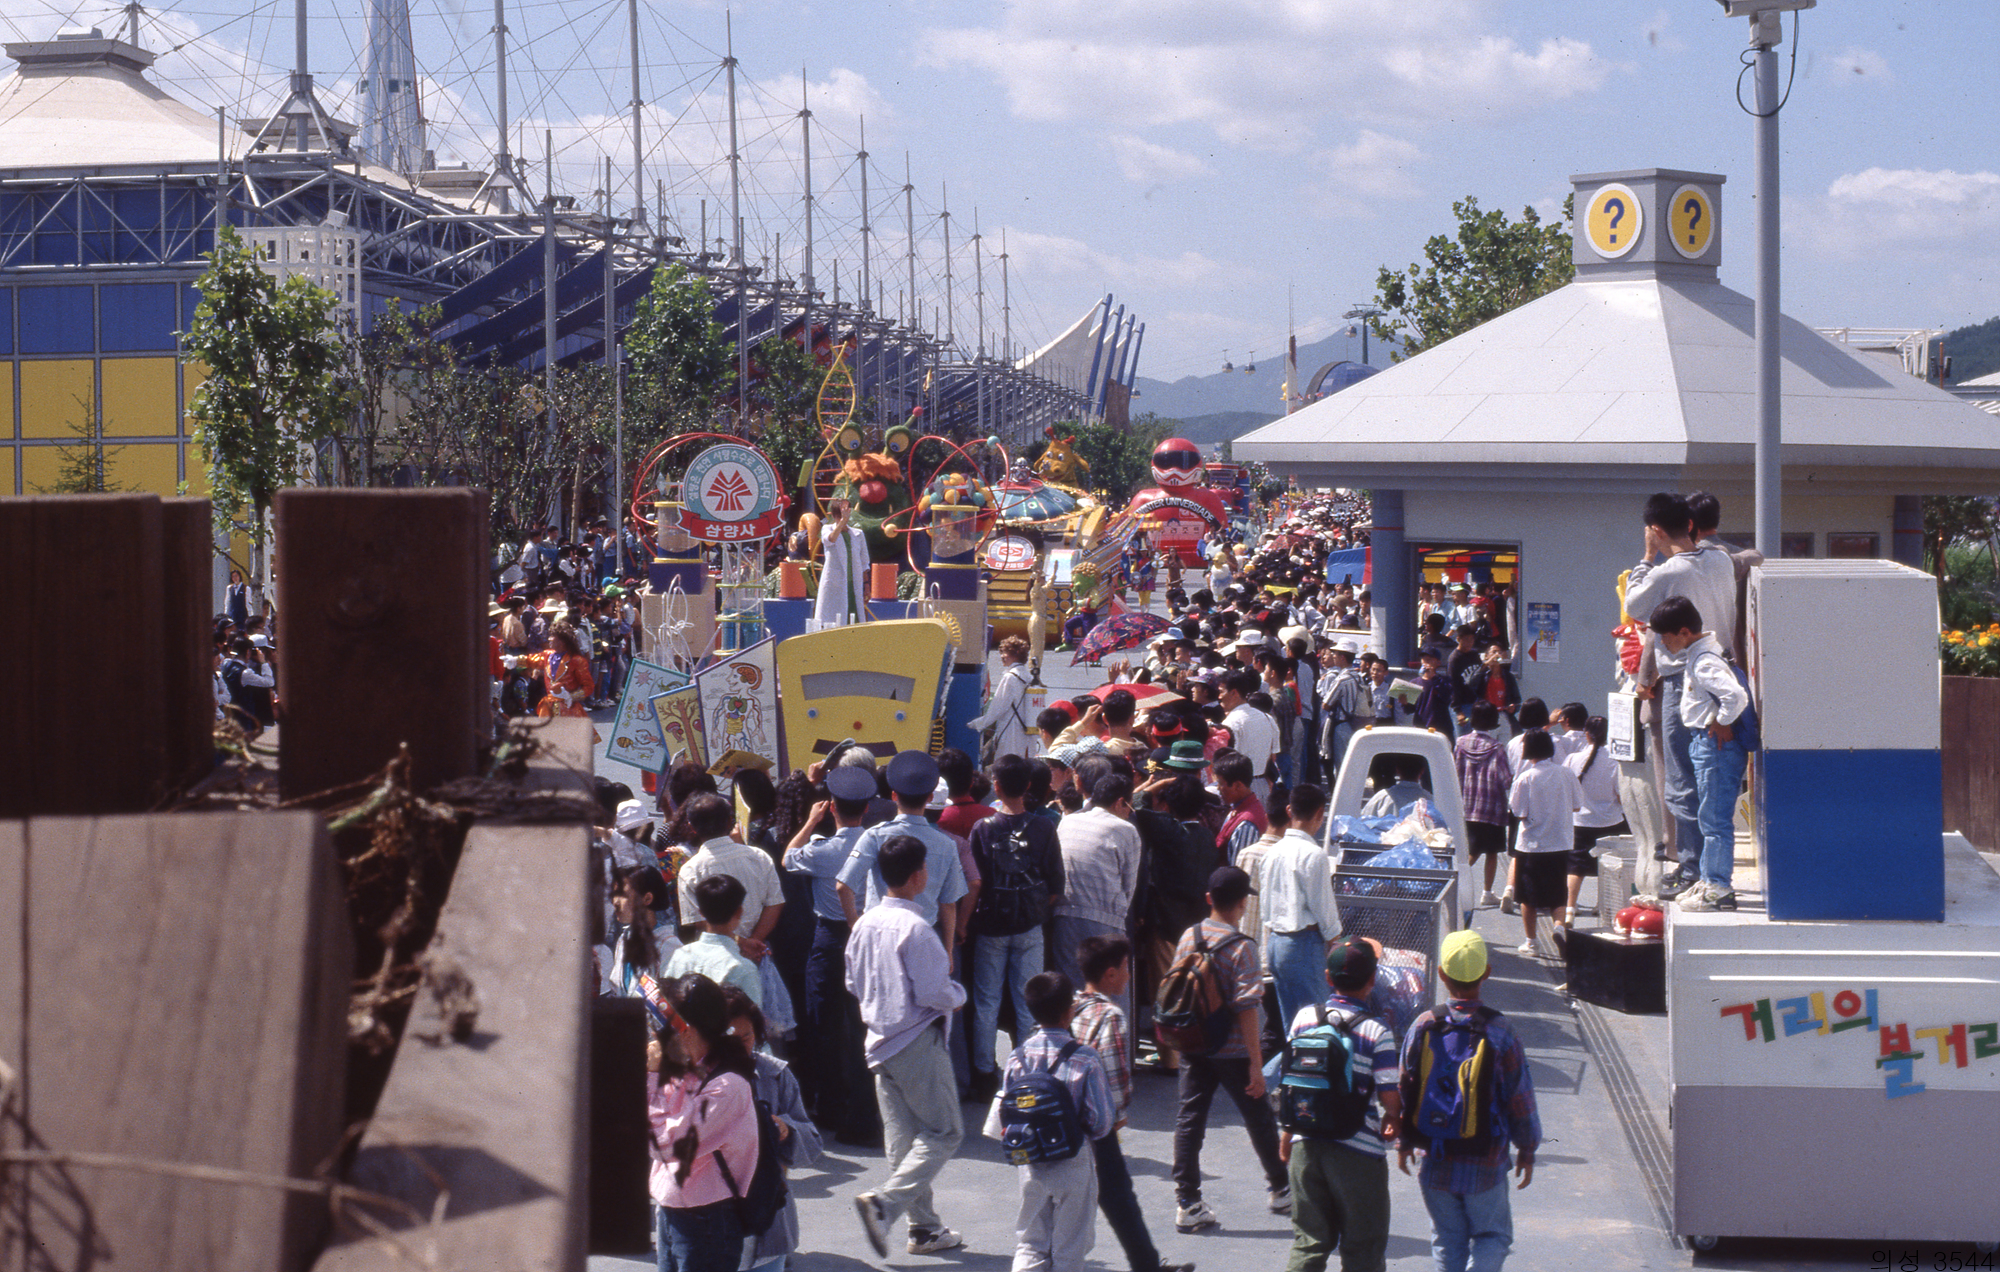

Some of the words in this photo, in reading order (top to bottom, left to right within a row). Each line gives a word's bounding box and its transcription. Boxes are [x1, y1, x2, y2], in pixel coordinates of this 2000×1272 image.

[1134, 498, 1165, 514] WINTER
[1165, 497, 1215, 523] UNIVERSIADE
[705, 523, 756, 538] 삼양사
[1720, 988, 1880, 1043] 거리의
